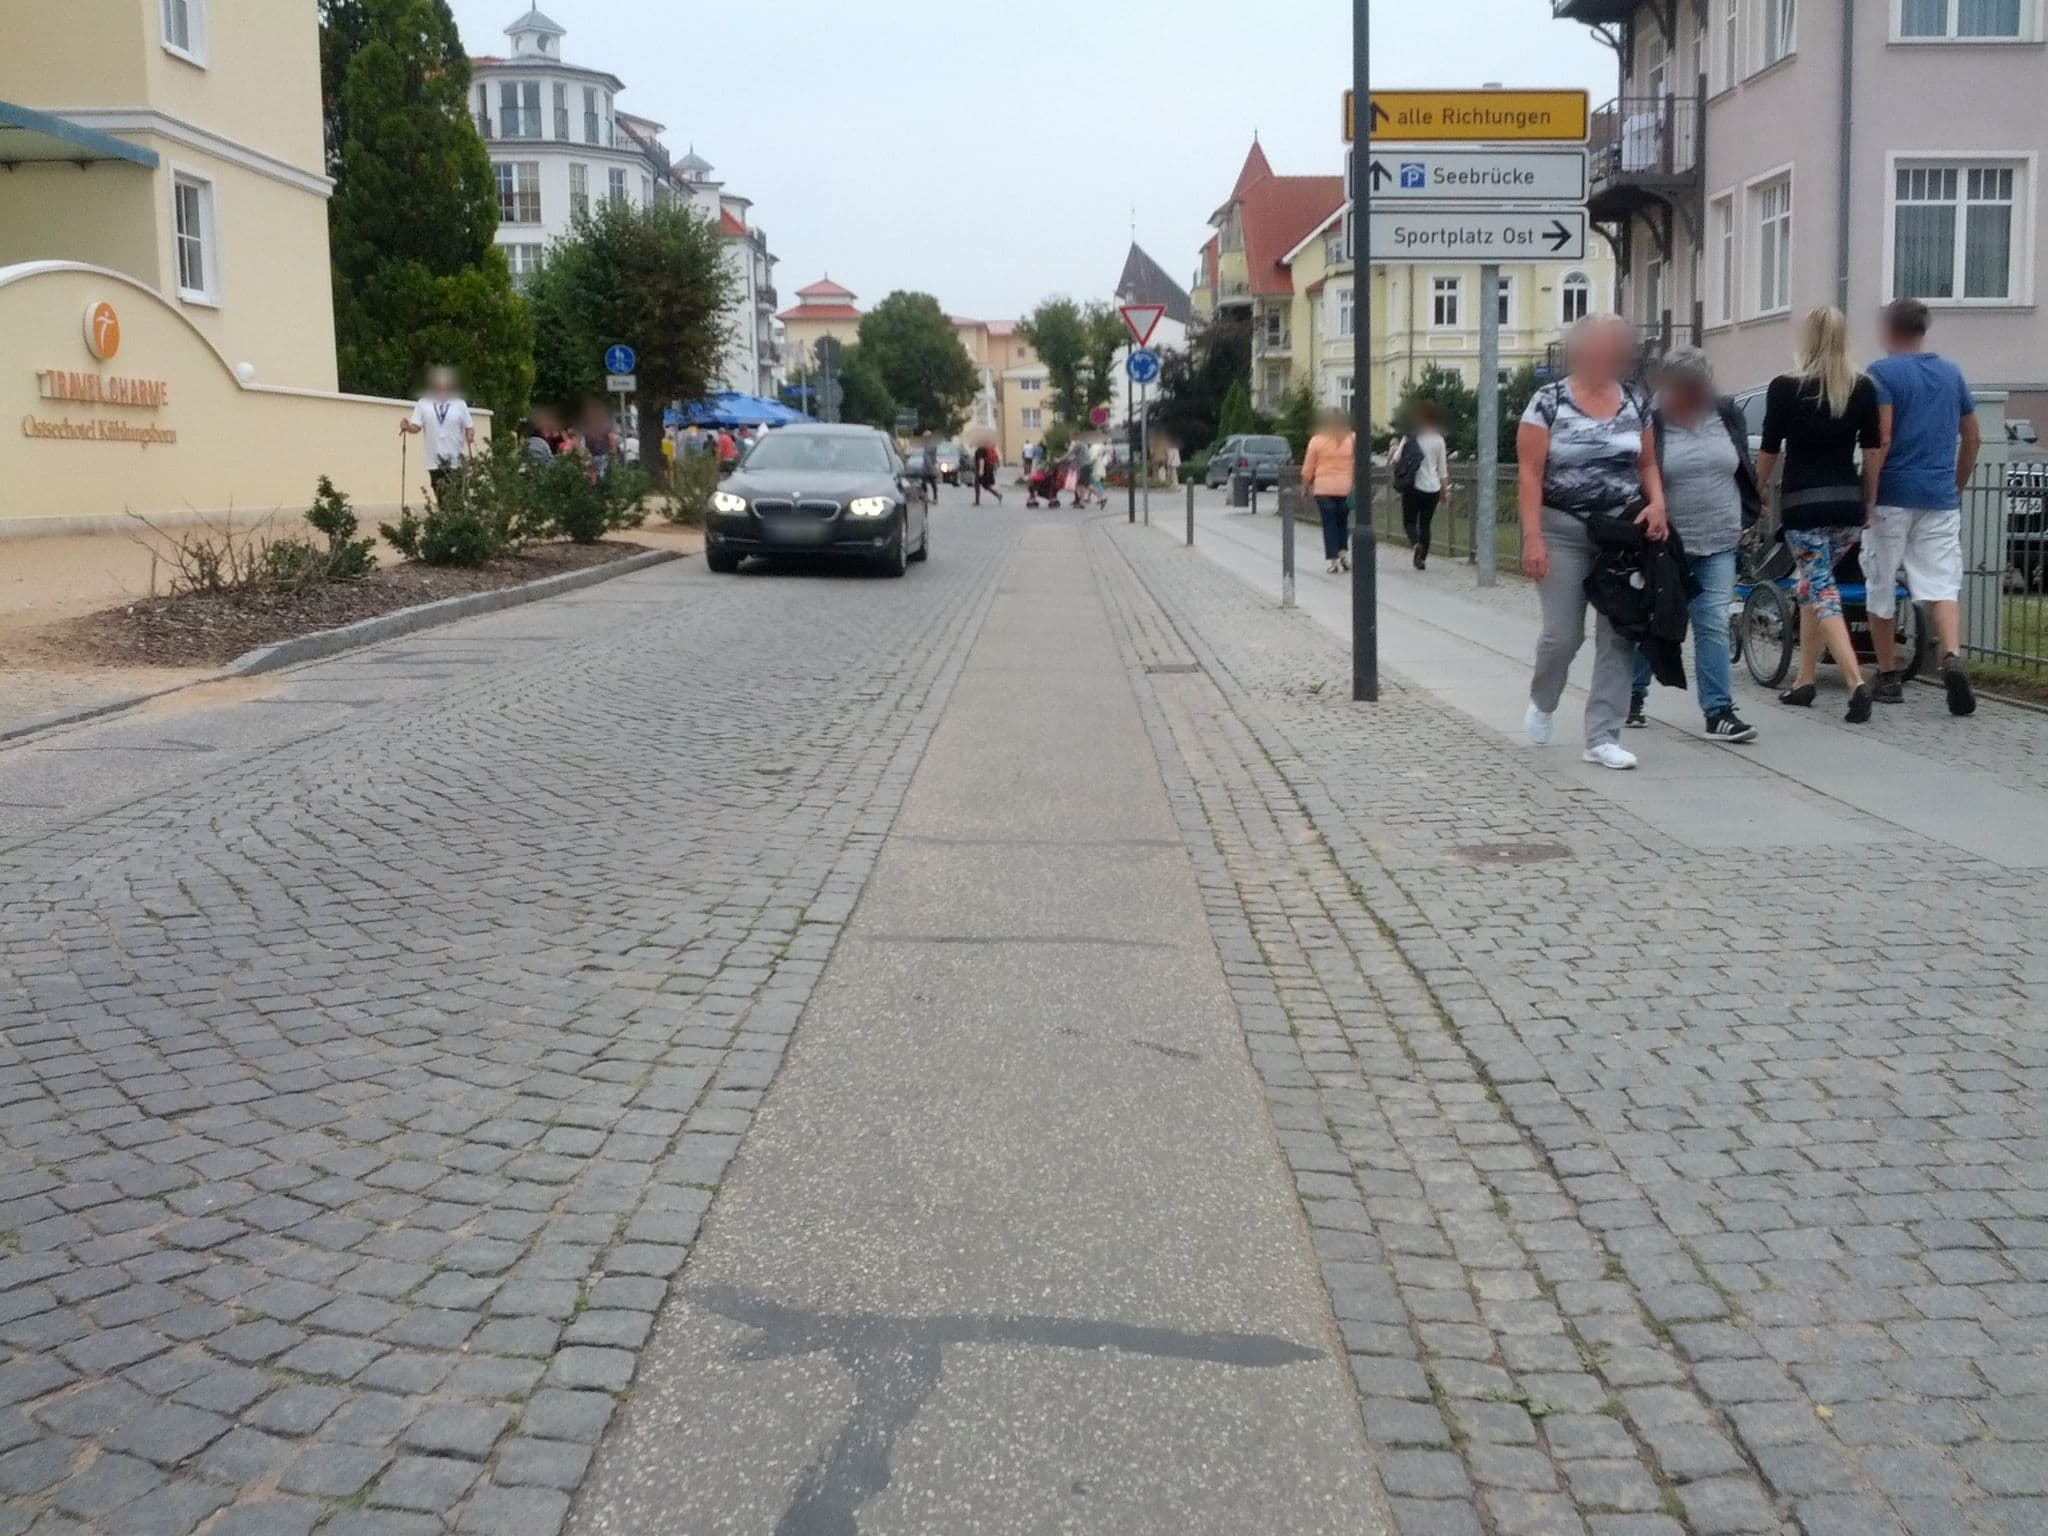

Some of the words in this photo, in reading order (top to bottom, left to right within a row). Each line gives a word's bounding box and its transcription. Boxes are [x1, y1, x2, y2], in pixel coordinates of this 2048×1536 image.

[1398, 108, 1433, 125] alle
[1442, 108, 1551, 129] Richtungen
[1433, 166, 1535, 185] Seebrücke
[1394, 227, 1493, 247] Sportplatz
[1503, 227, 1534, 244] Ost
[40, 369, 104, 402] TRAVEL
[107, 375, 168, 407] CHARME
